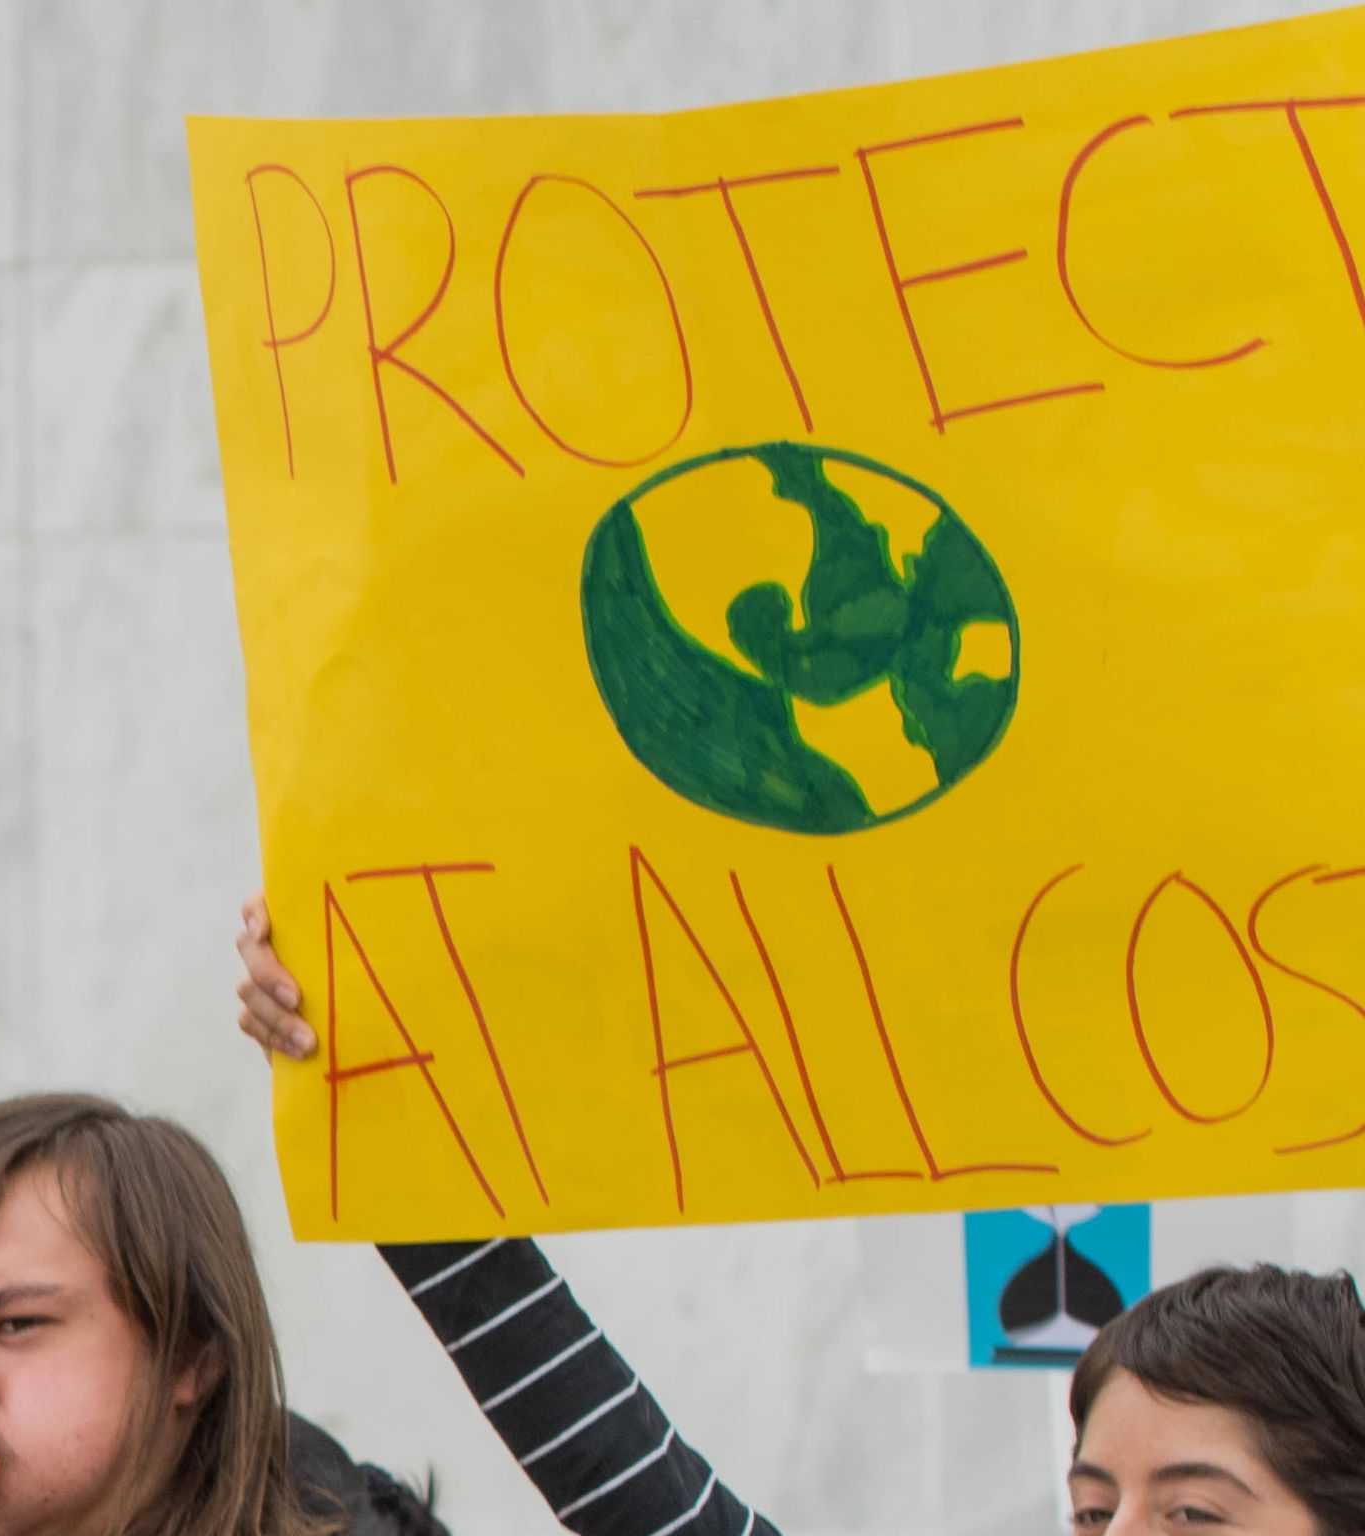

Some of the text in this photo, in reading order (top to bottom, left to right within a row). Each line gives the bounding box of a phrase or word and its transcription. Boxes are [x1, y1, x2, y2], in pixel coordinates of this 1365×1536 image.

[245, 97, 1365, 485] PROTECT
[324, 862, 551, 1221] AT
[630, 844, 1060, 1214] ALL
